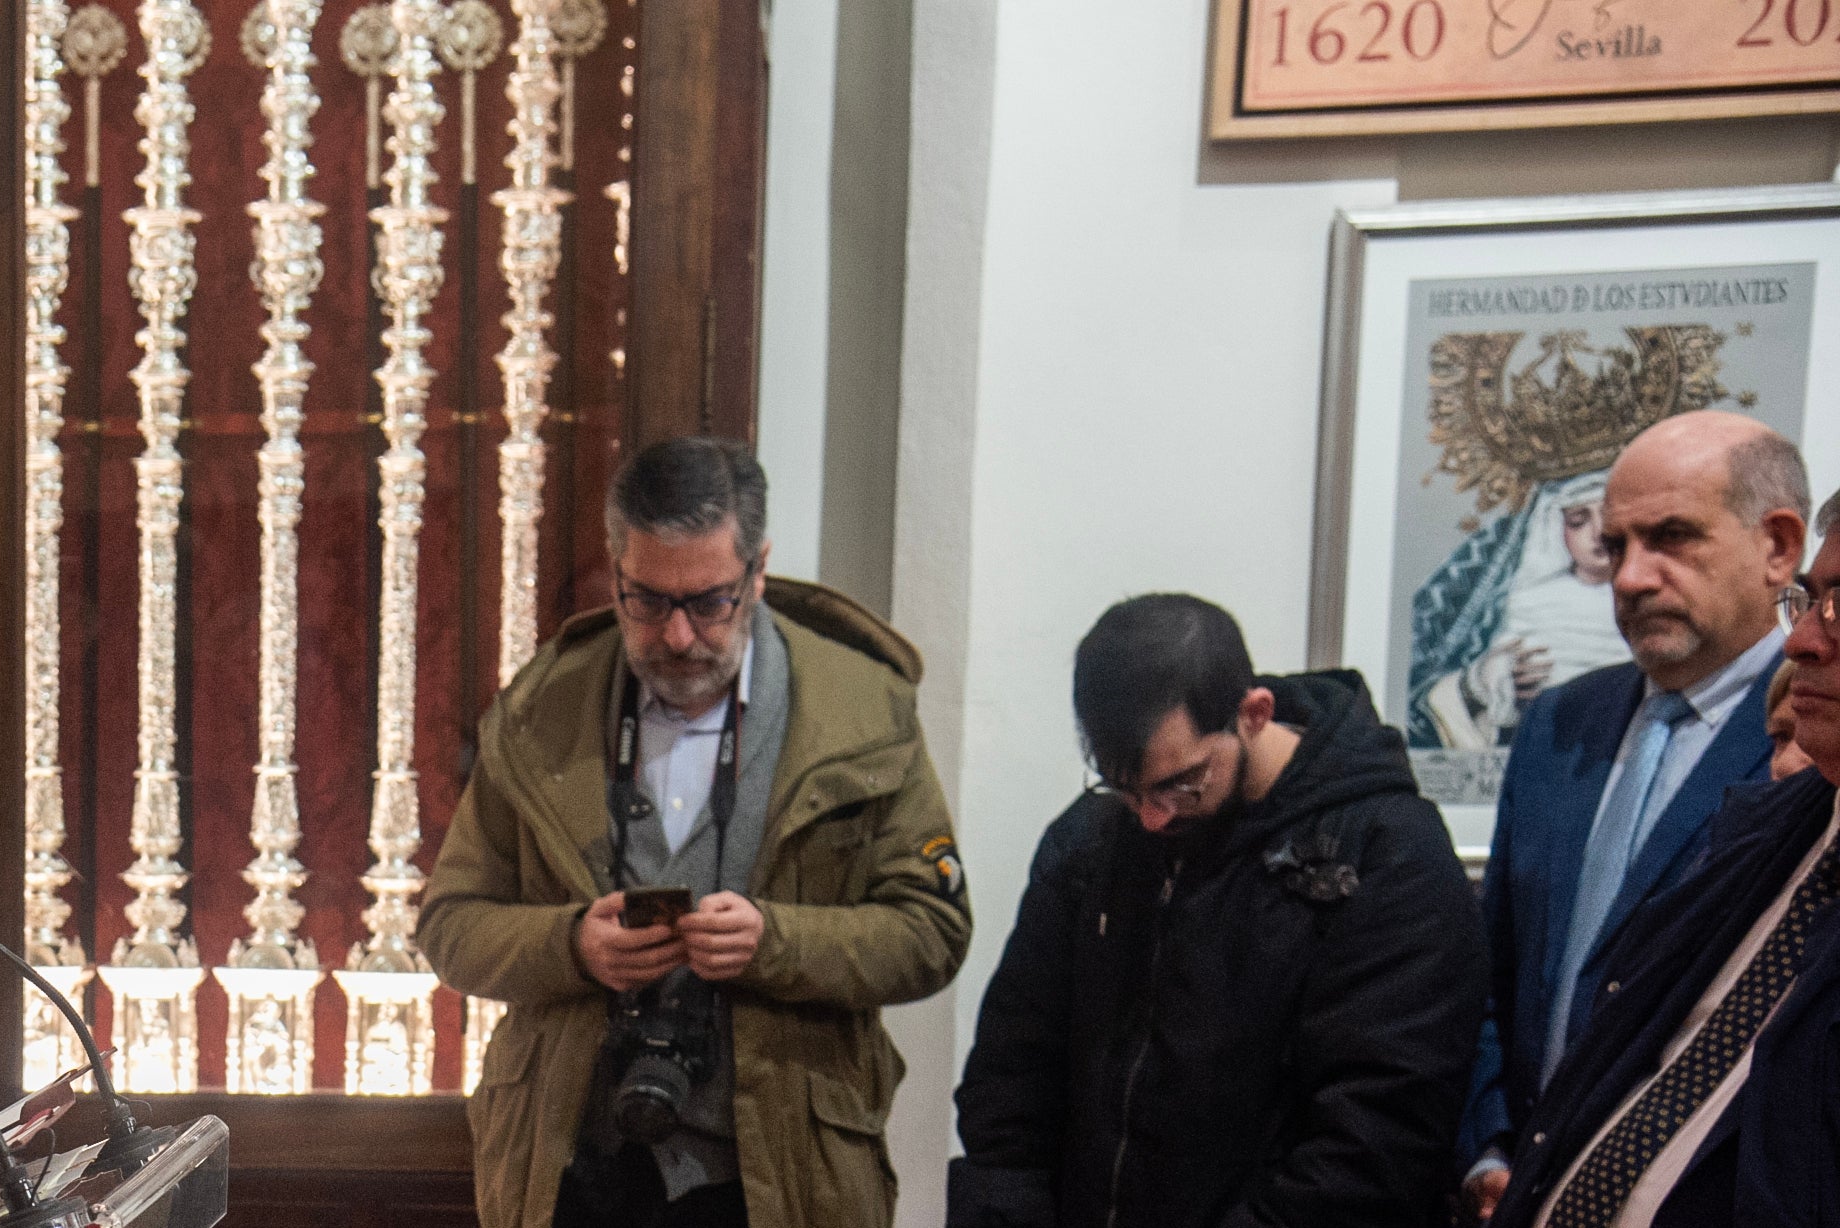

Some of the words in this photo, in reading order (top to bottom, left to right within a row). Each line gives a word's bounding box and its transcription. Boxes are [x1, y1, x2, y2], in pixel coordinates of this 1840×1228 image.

[1271, 0, 1446, 67] 1620
[1556, 23, 1663, 61] Sevilla
[1735, 0, 1840, 48] 20
[1427, 284, 1570, 318] HERMANDAD
[1592, 281, 1636, 312] LOS
